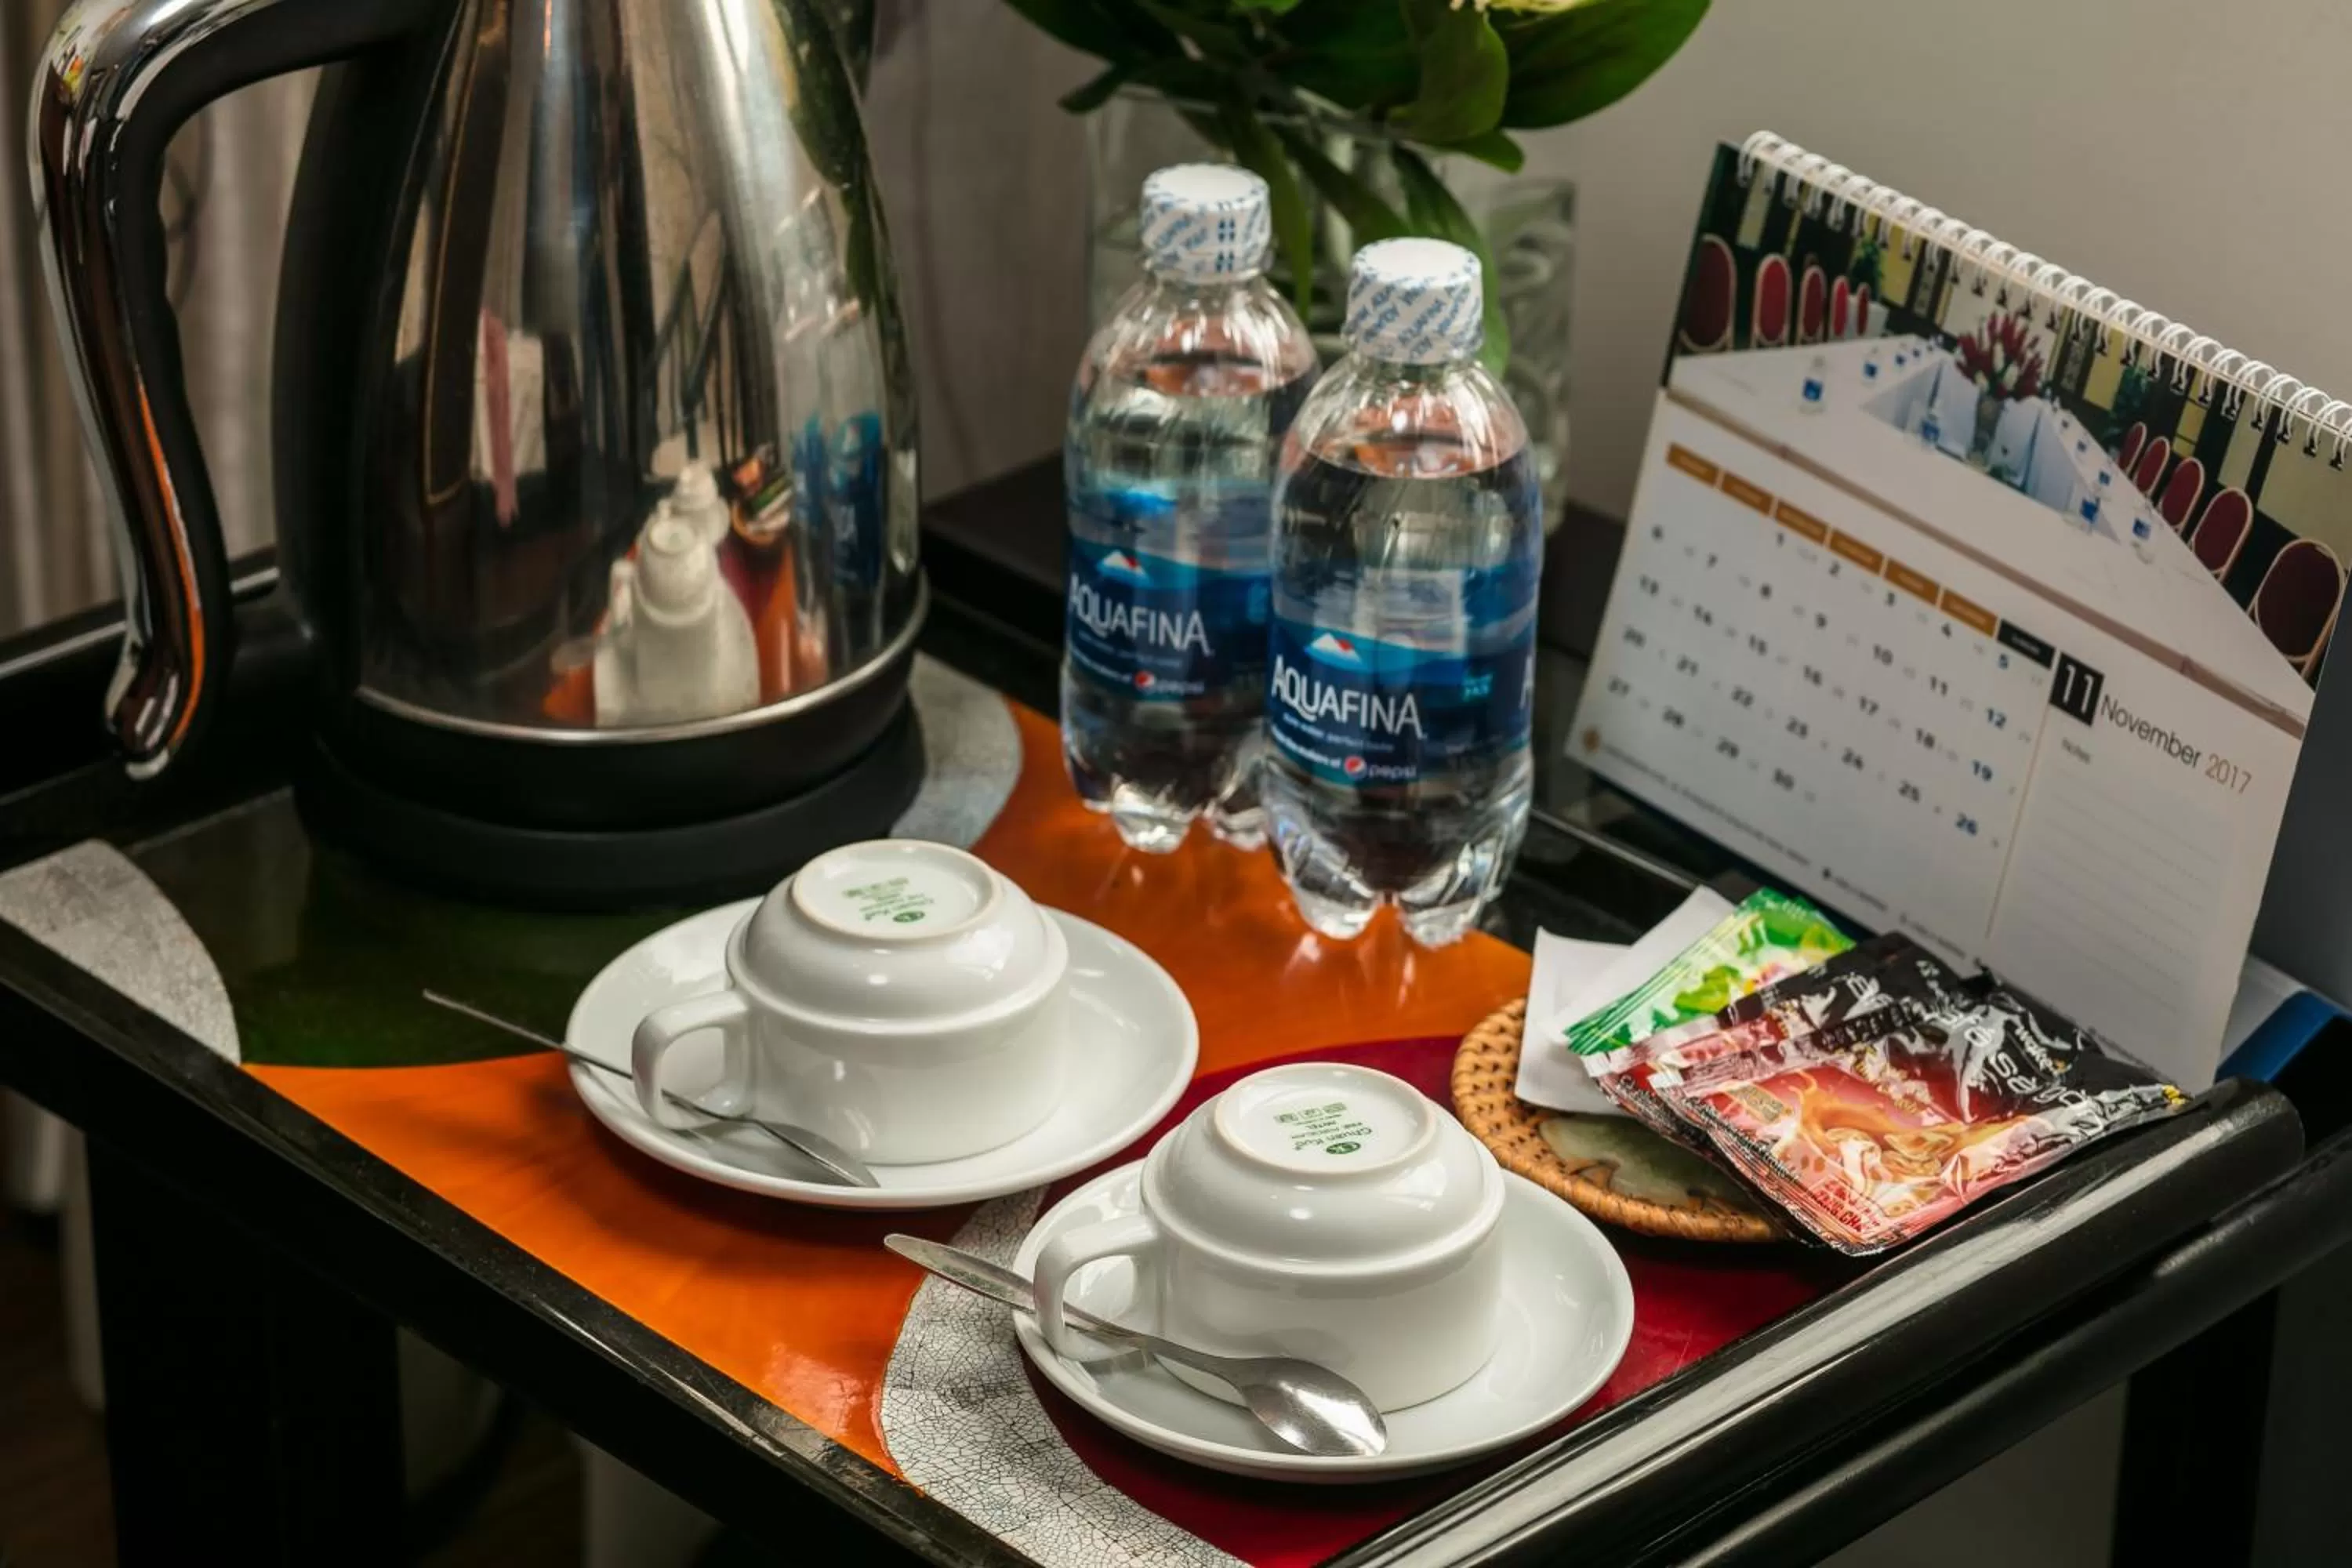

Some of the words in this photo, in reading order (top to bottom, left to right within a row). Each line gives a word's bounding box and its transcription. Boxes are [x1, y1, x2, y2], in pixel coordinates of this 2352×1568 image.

[1069, 572, 1212, 657] AQUAFINA
[1707, 554, 1719, 568] 7
[1815, 612, 1828, 629] 9
[1874, 644, 1893, 666] 10
[1929, 675, 1947, 695] 11
[1987, 707, 2007, 729] 12
[1777, 531, 1786, 547] 1
[1829, 561, 1840, 576] 2
[1886, 591, 1896, 608] 3
[1941, 622, 1951, 638] 4
[1998, 652, 2009, 670] 5
[1271, 655, 1424, 740] AQUAFINA
[1677, 654, 1699, 677] 21
[1731, 685, 1754, 708] 22
[1785, 716, 1808, 739] 23
[1842, 747, 1864, 771] 24
[1898, 780, 1920, 803] 25
[1955, 812, 1978, 837] 26
[1693, 604, 1712, 626] 14
[1748, 633, 1768, 656] 15
[1803, 665, 1822, 687] 16
[1859, 695, 1879, 716] 17
[1916, 728, 1935, 749] 18
[1973, 760, 1993, 782] 19
[2062, 662, 2094, 714] 11
[2101, 694, 2202, 768] November
[2204, 752, 2252, 794] 2017
[1368, 764, 1417, 780] pepsi
